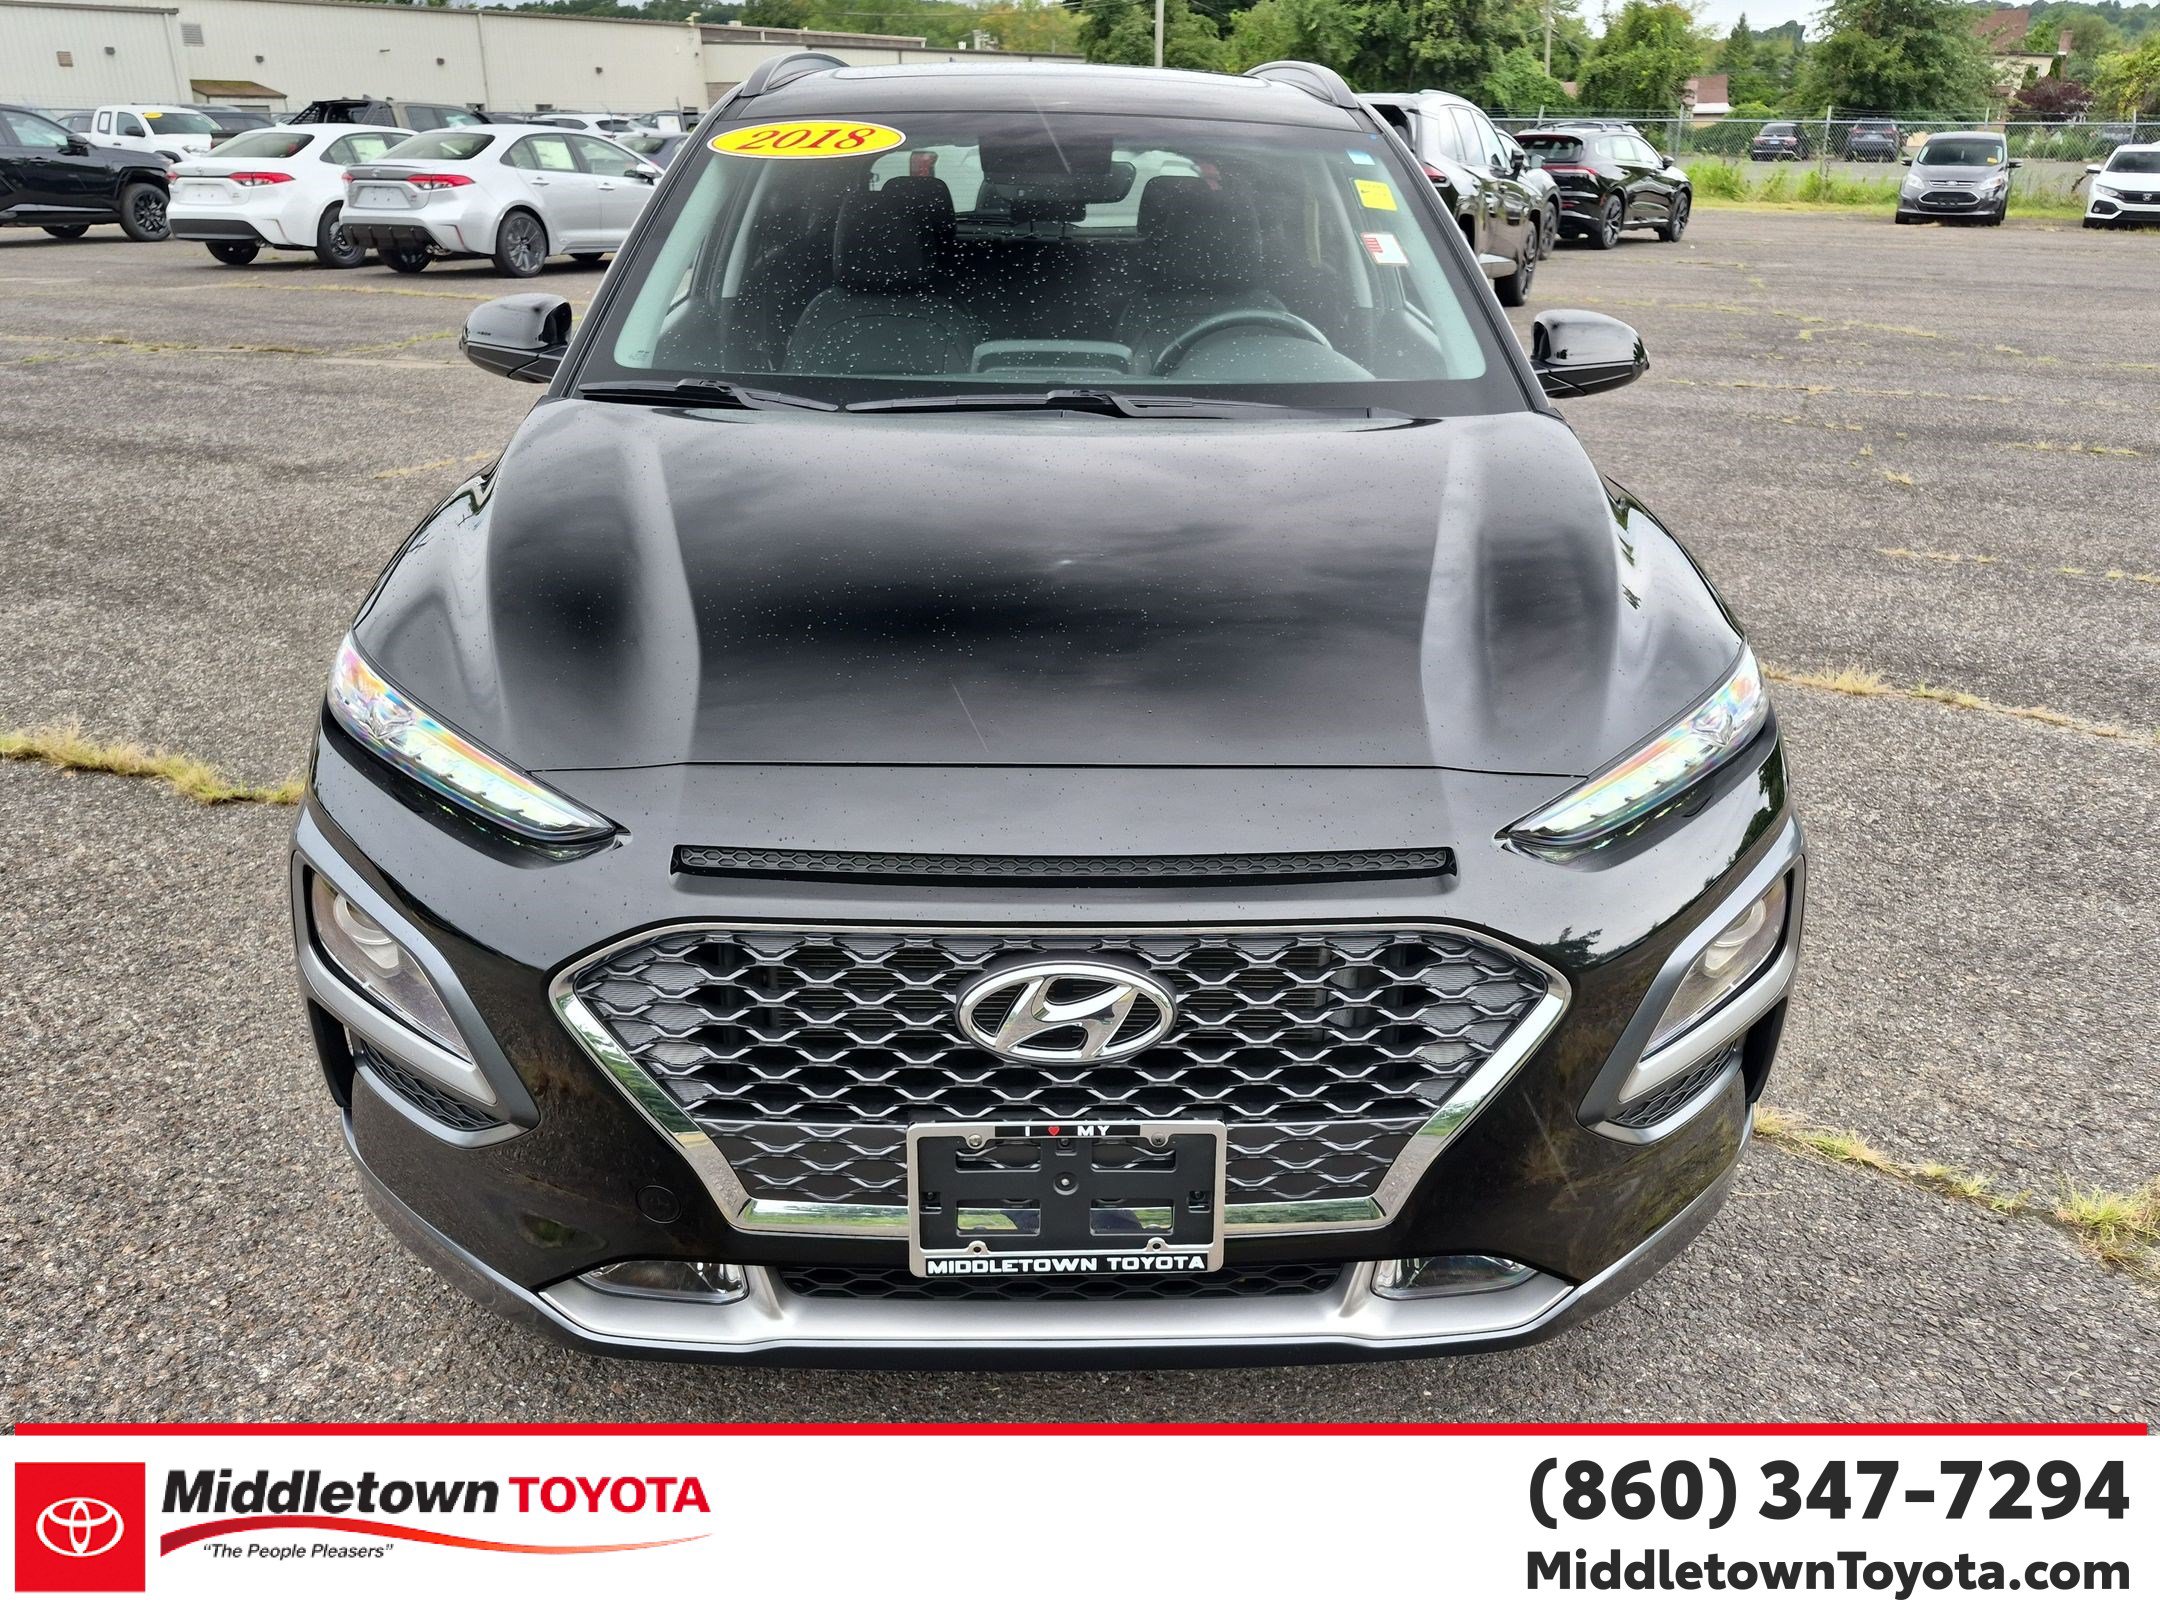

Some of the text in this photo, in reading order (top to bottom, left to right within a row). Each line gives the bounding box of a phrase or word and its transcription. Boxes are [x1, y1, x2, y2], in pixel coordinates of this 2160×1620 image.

[736, 128, 876, 150] 2018
[1024, 1125, 1111, 1137] I MY
[927, 1255, 1205, 1274] MIDDLETOWN TOYOTA
